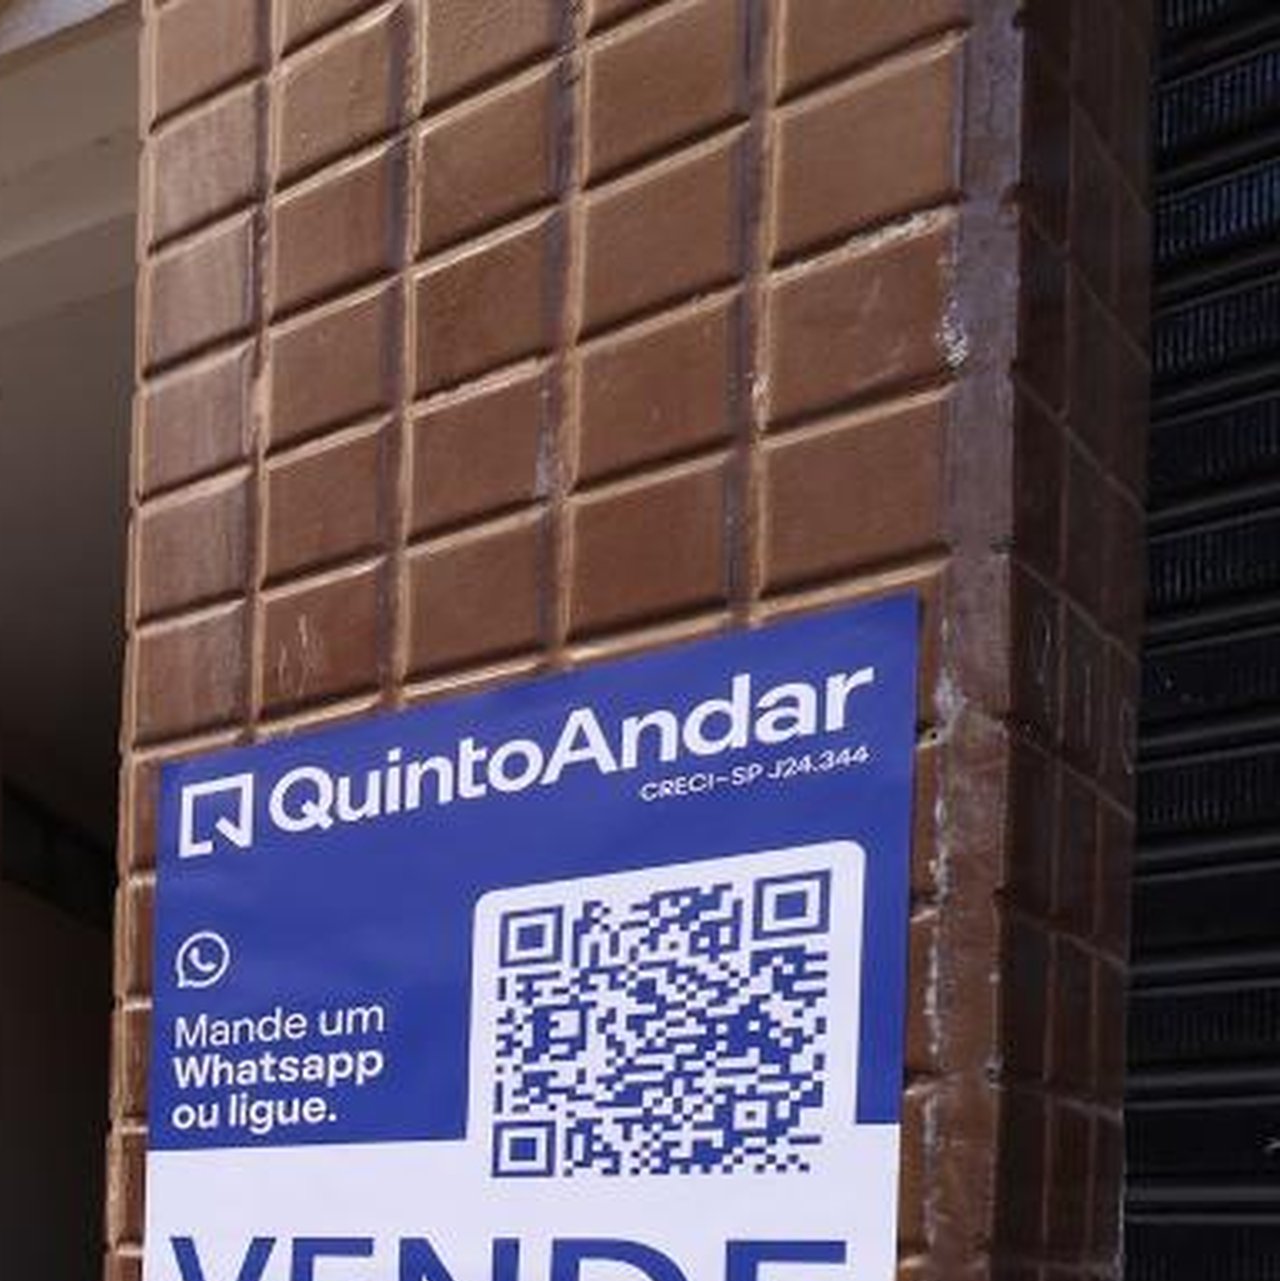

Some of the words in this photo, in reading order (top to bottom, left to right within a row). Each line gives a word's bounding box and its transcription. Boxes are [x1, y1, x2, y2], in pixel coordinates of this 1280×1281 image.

[268, 666, 874, 831] QuintoAndar
[641, 763, 763, 801] CRECI-SP
[175, 1008, 308, 1048] Mande
[319, 1005, 384, 1036] um
[173, 1050, 384, 1089] Whatsapp
[172, 1103, 219, 1130] ou
[228, 1092, 337, 1135] ligue.
